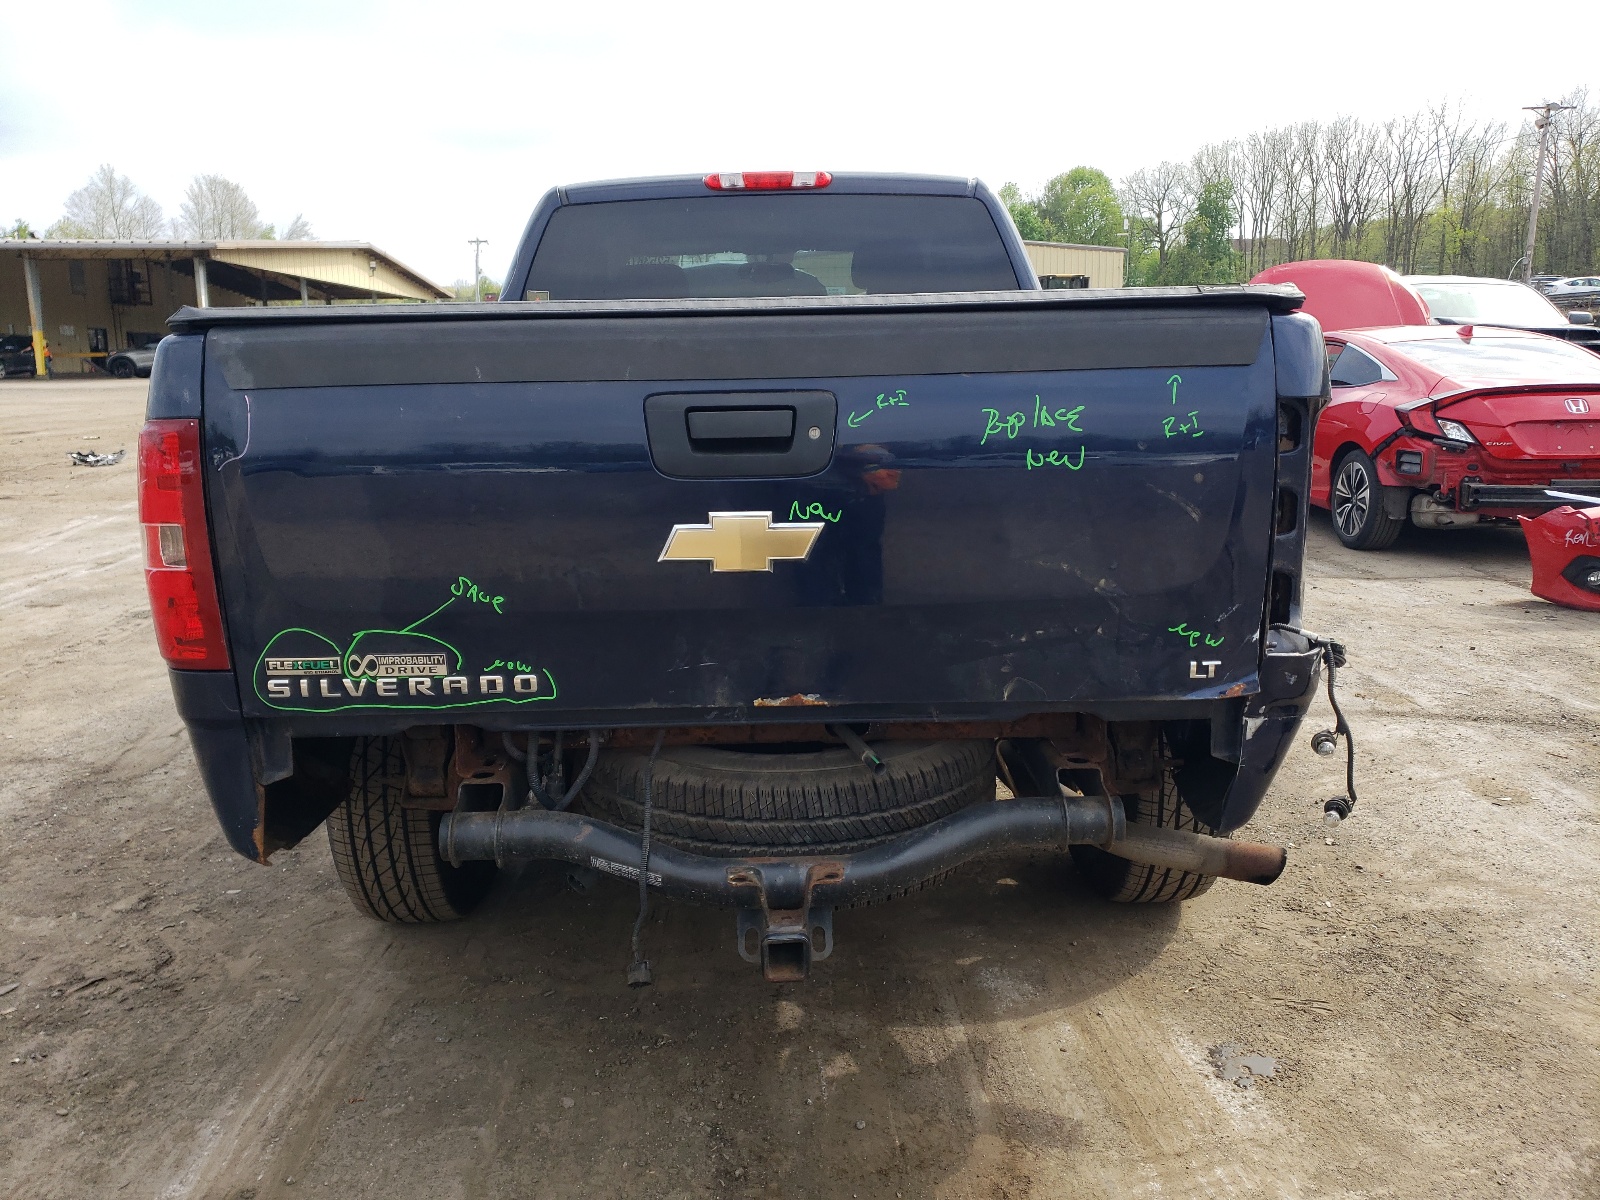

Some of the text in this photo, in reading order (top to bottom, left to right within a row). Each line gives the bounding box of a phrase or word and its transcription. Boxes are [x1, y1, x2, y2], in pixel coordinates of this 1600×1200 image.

[268, 660, 338, 670] FLEXFUEL
[378, 655, 444, 665] IMPROBABILITY
[385, 666, 438, 674] DRIVE
[1189, 660, 1222, 678] LT
[267, 675, 538, 698] SILVERADO
